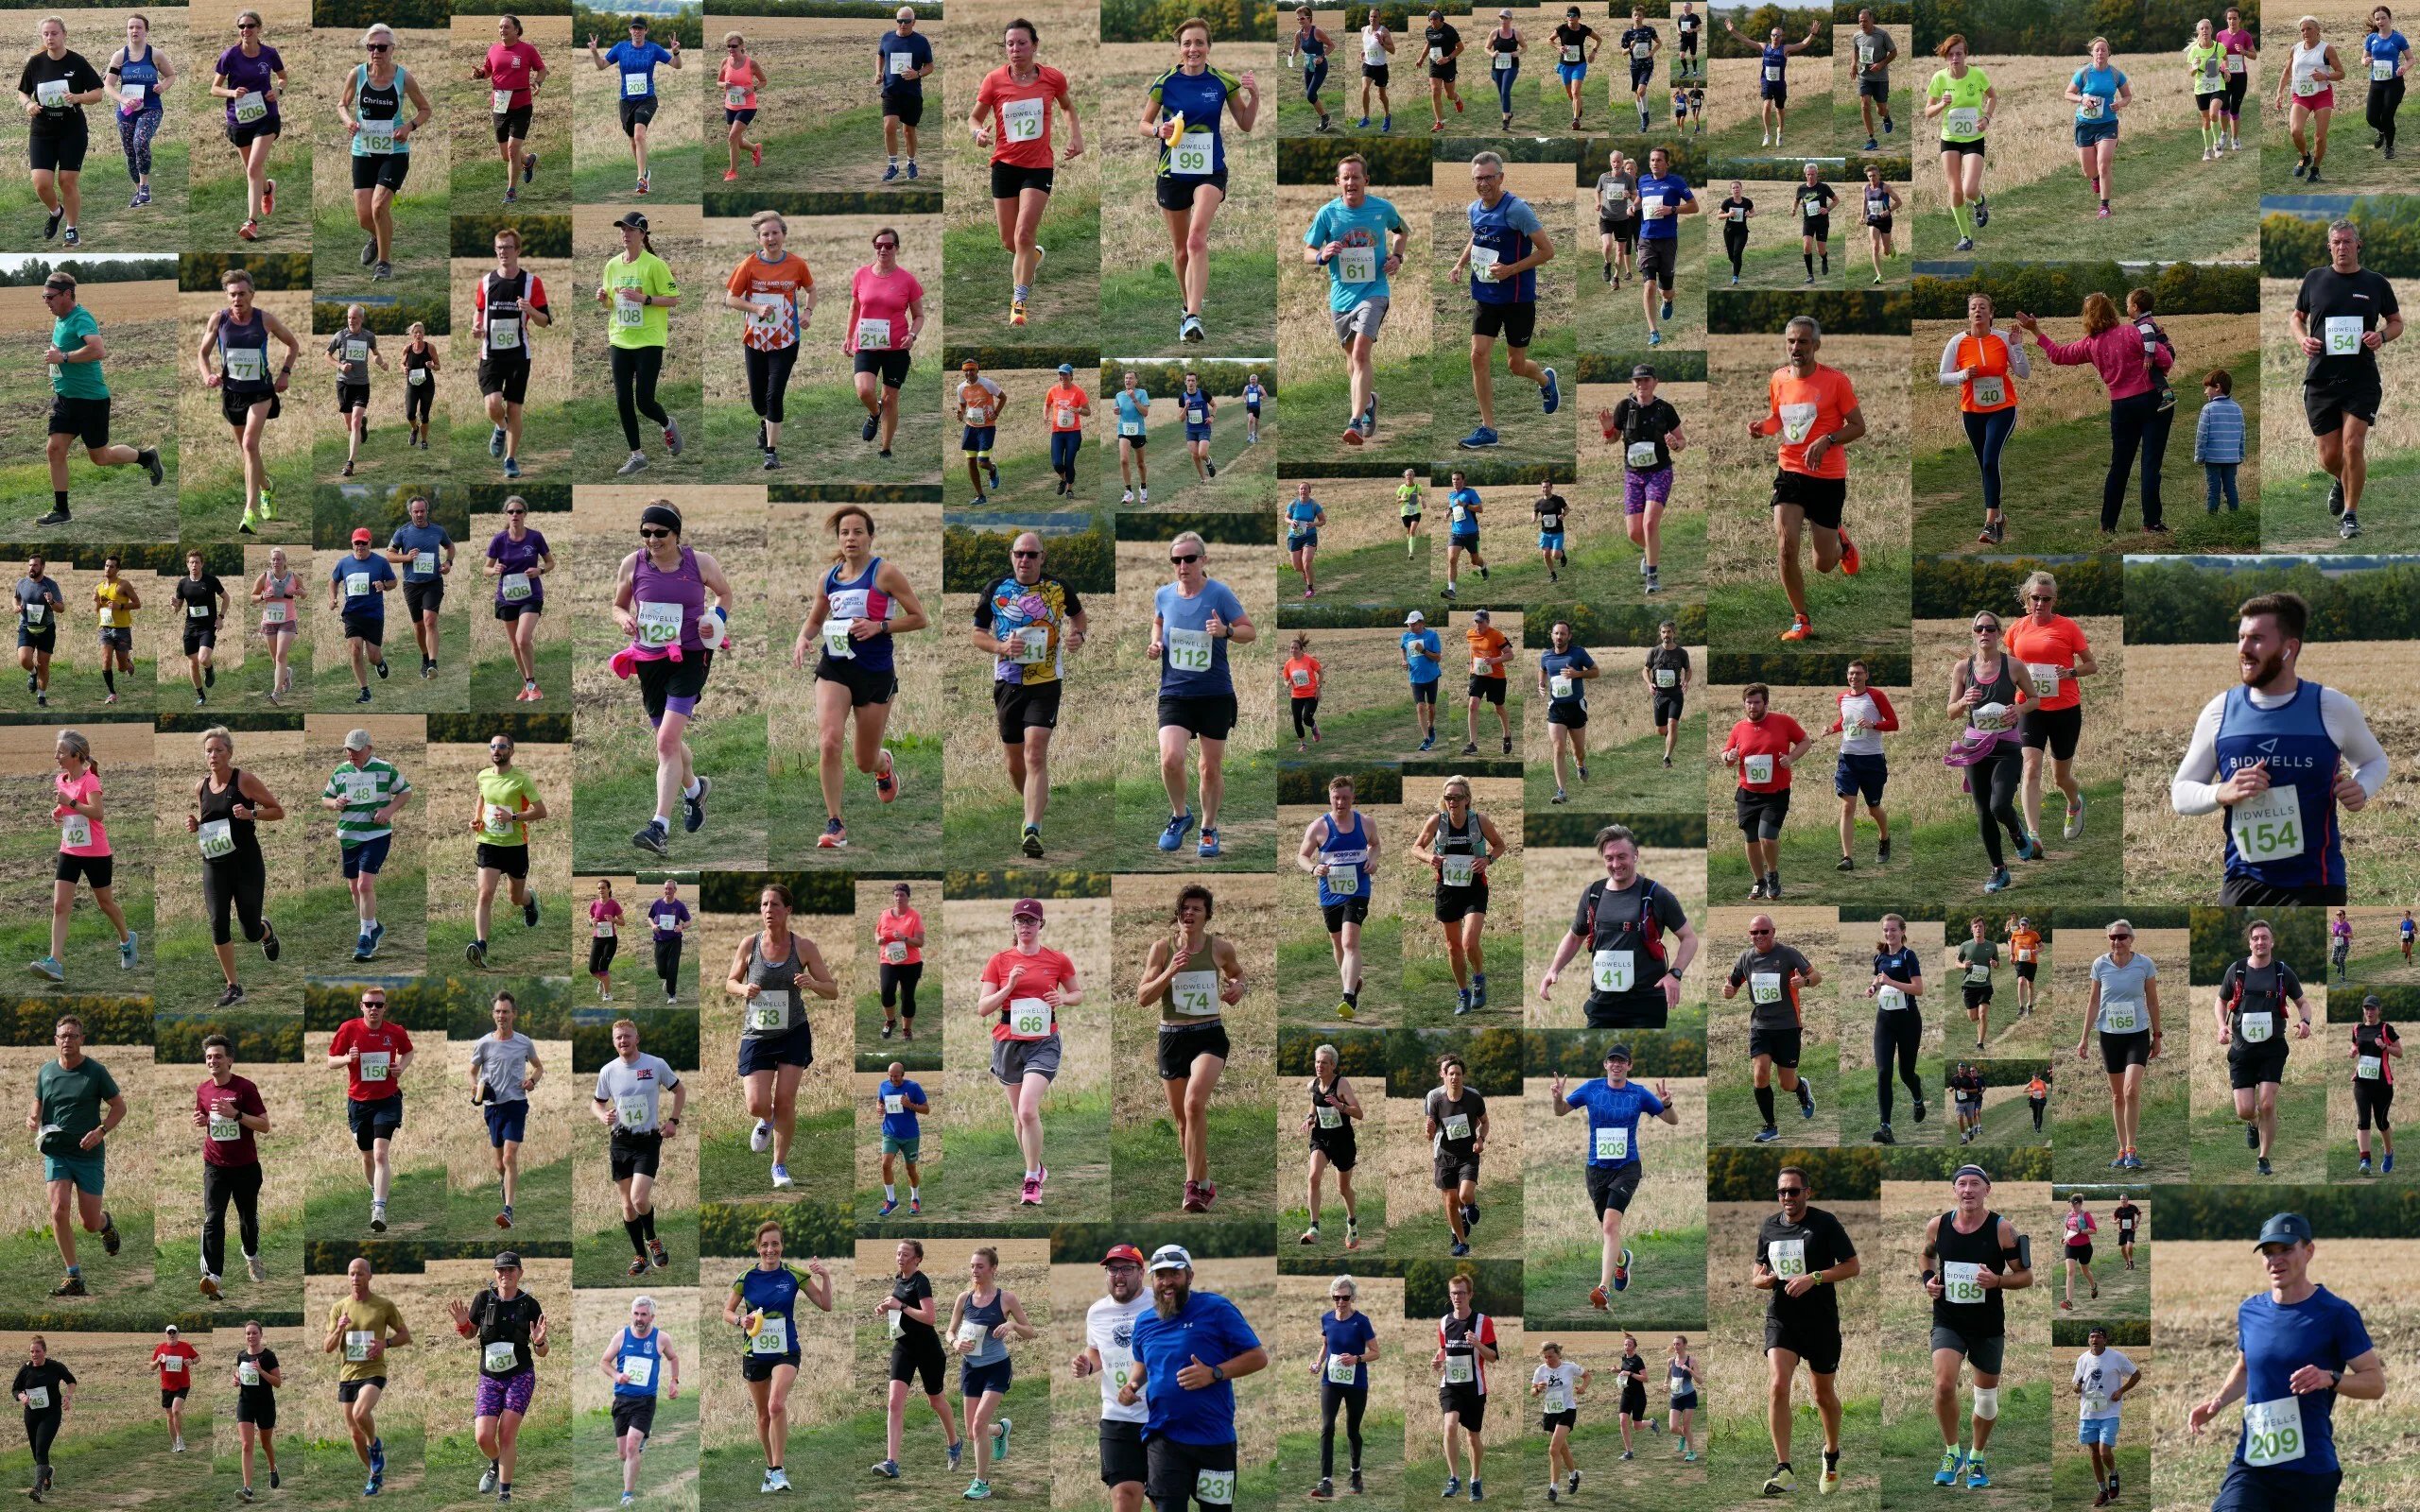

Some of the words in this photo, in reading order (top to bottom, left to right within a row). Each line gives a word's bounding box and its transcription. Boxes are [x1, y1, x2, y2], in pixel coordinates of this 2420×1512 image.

[898, 63, 904, 72] 2
[2229, 62, 2239, 71] 30
[2374, 70, 2391, 78] 174
[628, 83, 646, 93] 203
[2205, 82, 2216, 91] 21
[2301, 84, 2314, 94] 24
[47, 94, 65, 108] 44
[363, 96, 393, 106] Chrissie
[730, 94, 740, 104] 81
[237, 106, 265, 121] 208
[1005, 110, 1042, 119] BIDWELLS
[1013, 118, 1036, 137] 12
[1955, 121, 1973, 133] 20
[363, 136, 392, 150] 162
[1179, 152, 1204, 169] 99
[1346, 264, 1366, 279] 61
[617, 309, 641, 323] 108
[497, 334, 514, 345] 96
[861, 334, 889, 346] 214
[2333, 335, 2356, 351] 54
[349, 350, 366, 358] 123
[233, 364, 253, 377] 77
[1980, 390, 1999, 404] 40
[1631, 453, 1653, 467] 137
[415, 562, 433, 572] 125
[506, 586, 530, 598] 208
[268, 611, 284, 621] 117
[640, 613, 680, 623] BIDWELLS
[641, 624, 677, 643] 129
[1172, 638, 1209, 647] BIDWELLS
[1173, 647, 1208, 668] 112
[1478, 665, 1489, 674] 16
[2230, 755, 2314, 769] BIDWELLS
[1751, 768, 1768, 780] 90
[353, 788, 370, 800] 48
[2235, 806, 2296, 821] BIDWELLS
[67, 830, 85, 844] 42
[2237, 821, 2298, 855] 154
[202, 836, 232, 854] 100
[1446, 869, 1471, 884] 144
[1331, 880, 1357, 892] 179
[889, 951, 907, 961] 183
[1601, 971, 1622, 987] 41
[1175, 983, 1216, 991] BIDWELLS
[1183, 992, 1209, 1010] 74
[1755, 988, 1779, 1001] 136
[1883, 996, 1898, 1006] 71
[757, 1009, 780, 1025] 53
[2108, 1015, 2135, 1029] 165
[1019, 1016, 1043, 1033] 66
[2249, 1026, 2264, 1039] 41
[363, 1066, 389, 1078] 150
[2360, 1067, 2377, 1077] 109
[625, 1109, 643, 1123] 14
[211, 1125, 238, 1138] 205
[1599, 1143, 1625, 1156] 203
[1946, 1272, 1975, 1280] BIDWEL
[1947, 1281, 1983, 1299] 185
[759, 1334, 780, 1349] 99
[489, 1355, 512, 1370] 137
[630, 1369, 644, 1383] 25
[1329, 1368, 1353, 1381] 138
[1451, 1369, 1467, 1379] 96
[31, 1397, 44, 1407] 43
[1546, 1401, 1563, 1412] 142
[2093, 1400, 2099, 1410] 1
[2250, 1428, 2299, 1460] 209
[1197, 1477, 1232, 1499] 231
